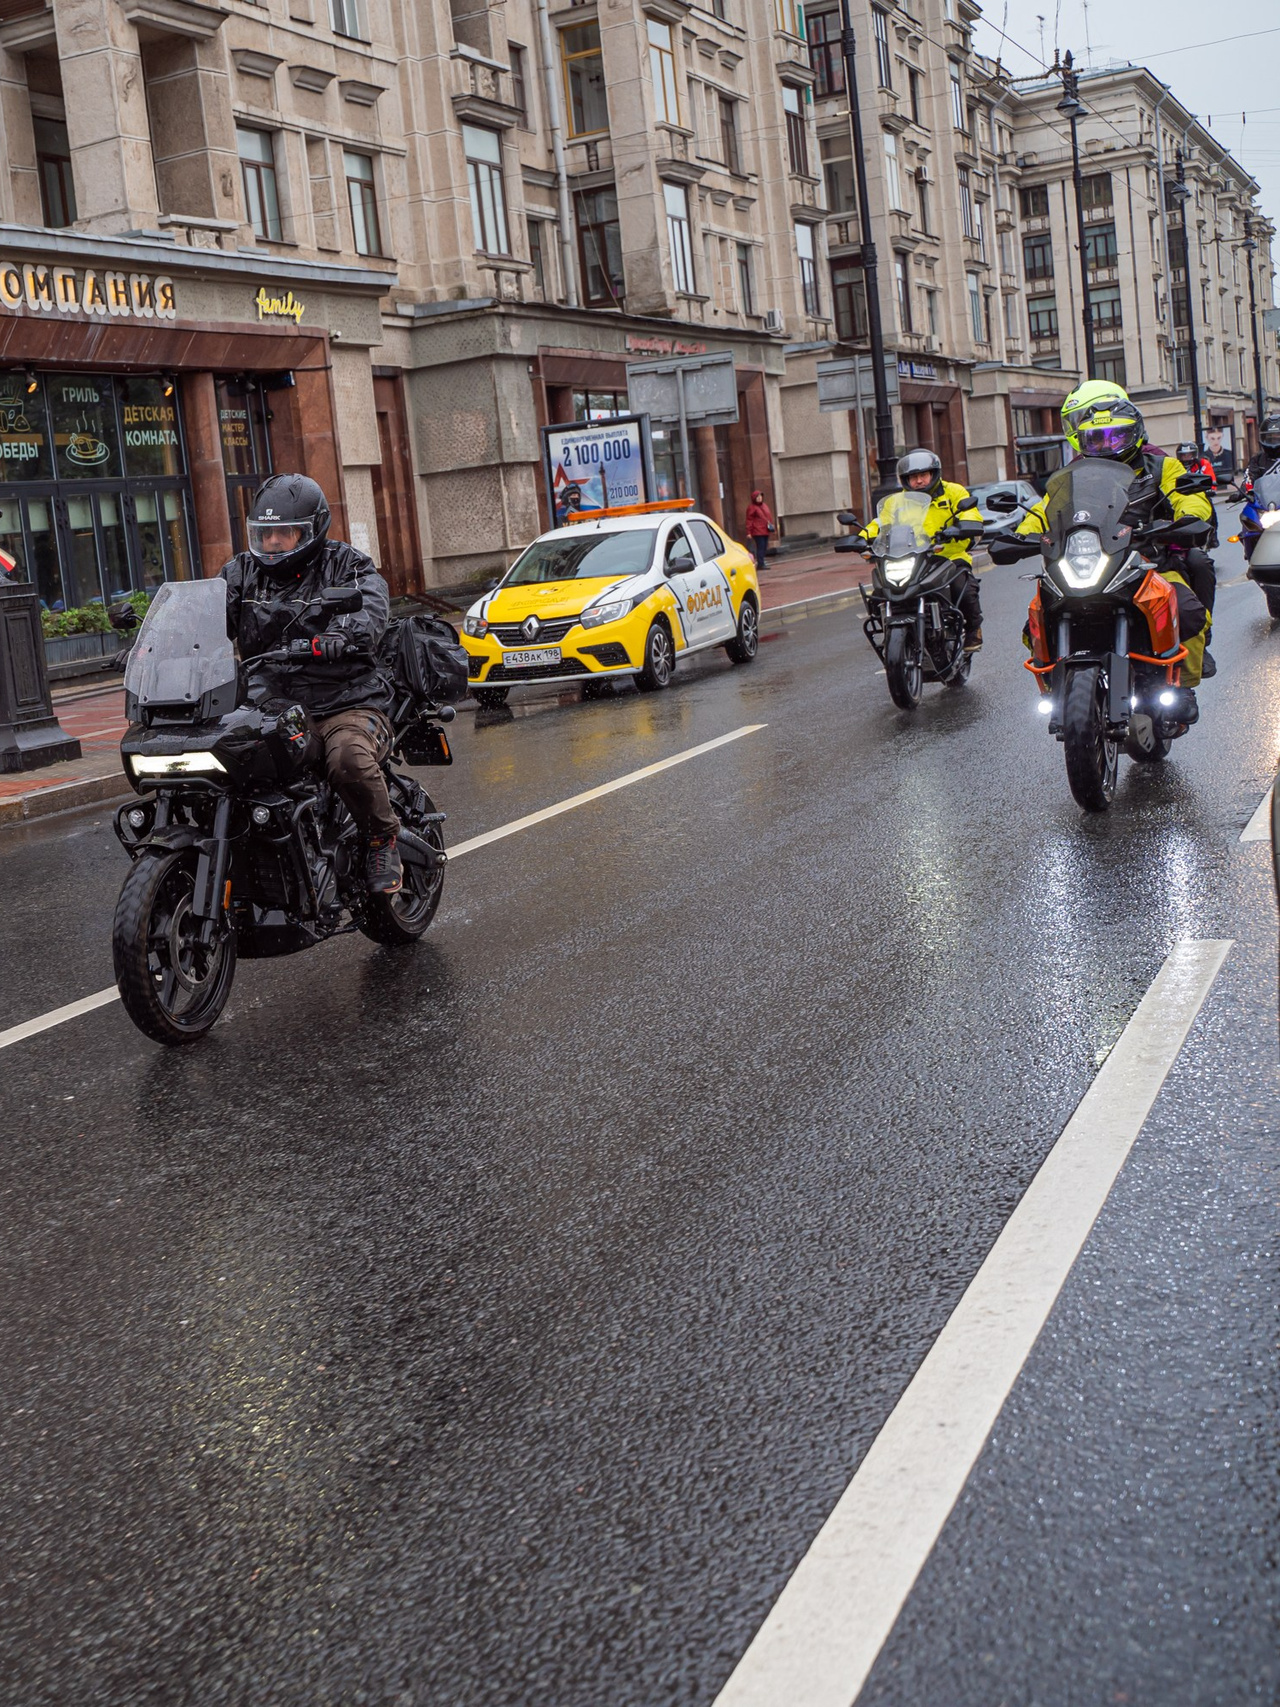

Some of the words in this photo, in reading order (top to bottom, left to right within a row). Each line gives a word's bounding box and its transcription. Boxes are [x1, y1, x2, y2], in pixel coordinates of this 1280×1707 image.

[256, 286, 305, 323] family
[62, 387, 100, 403] ГРИЛЬ
[124, 405, 175, 425] ДЕТСКАЯ
[125, 430, 178, 446] КОМНАТА
[563, 446, 572, 467] 2
[575, 442, 599, 465] 100
[603, 438, 631, 462] 000
[624, 484, 639, 497] 000
[686, 584, 723, 614] ФОРСАД
